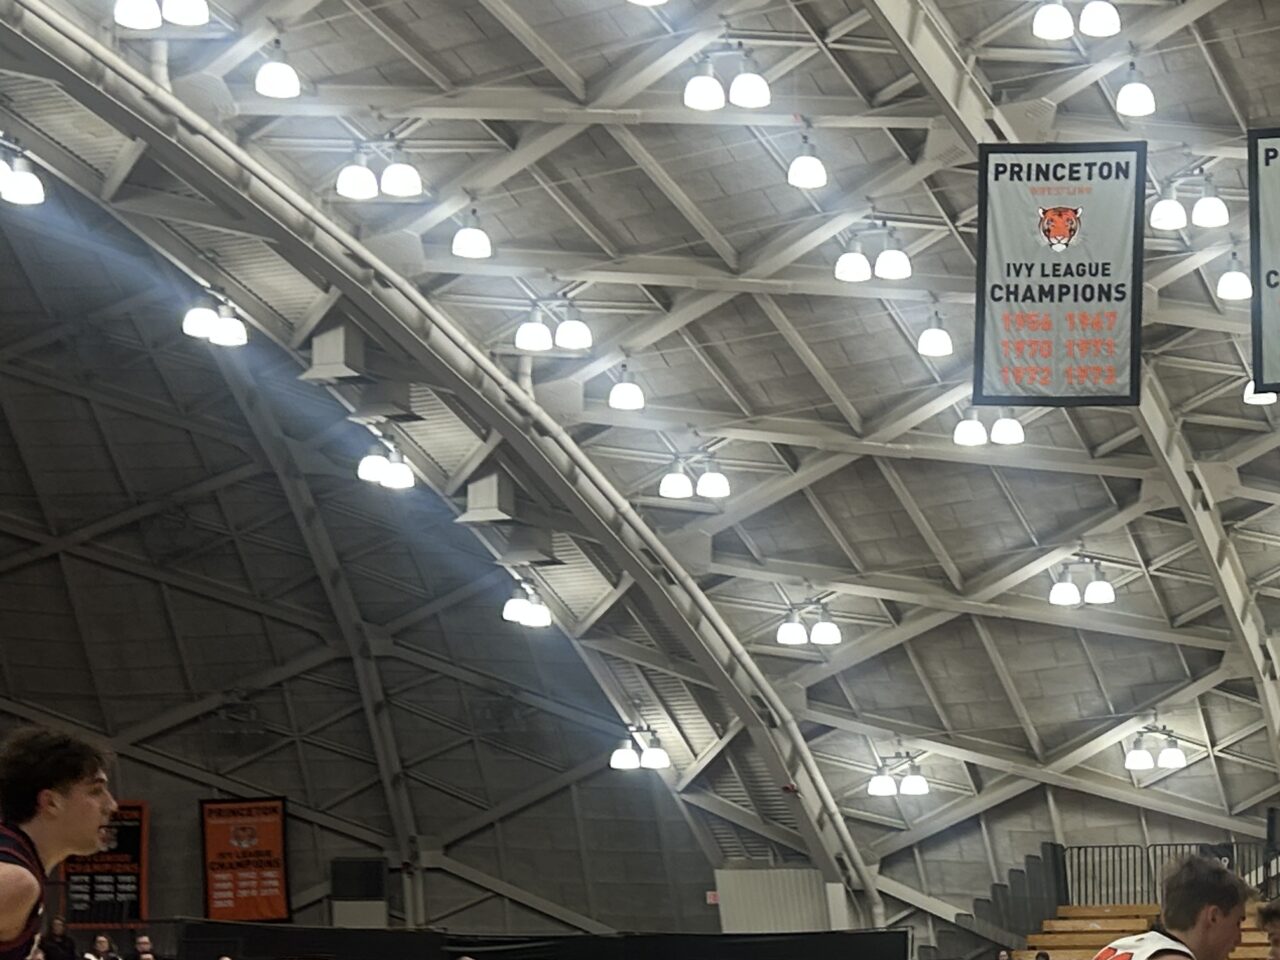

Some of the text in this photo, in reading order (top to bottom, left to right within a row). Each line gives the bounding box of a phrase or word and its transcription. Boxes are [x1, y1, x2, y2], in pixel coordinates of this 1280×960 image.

[993, 161, 1131, 181] PRINCETON
[1005, 262, 1111, 278] IVY LEAGUE
[990, 283, 1127, 303] CHAMPIONS
